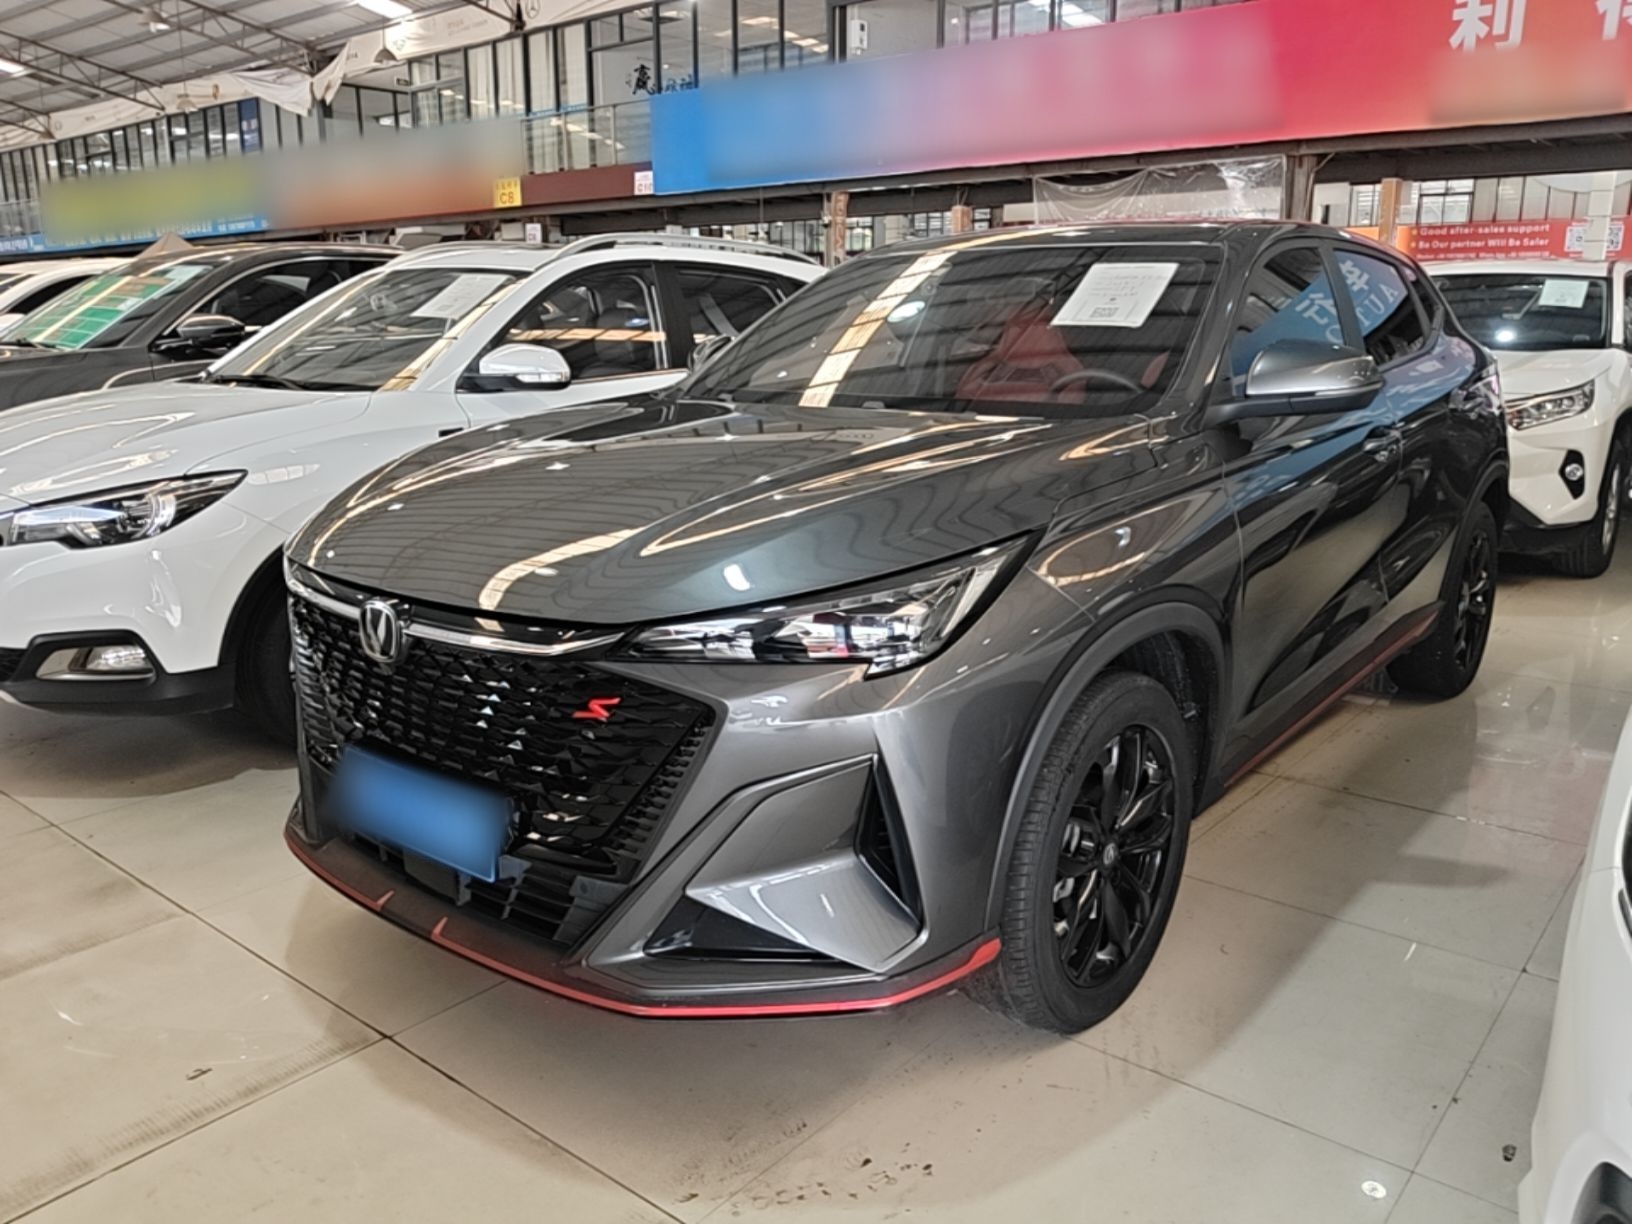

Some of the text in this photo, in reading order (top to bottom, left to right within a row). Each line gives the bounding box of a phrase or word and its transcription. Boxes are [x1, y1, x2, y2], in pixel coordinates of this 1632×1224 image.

[1420, 227, 1447, 236] Good
[1508, 224, 1549, 234] support
[1431, 240, 1449, 248] Our
[1450, 240, 1485, 250] partner
[1487, 238, 1507, 247] Will
[1523, 237, 1549, 247] Safer
